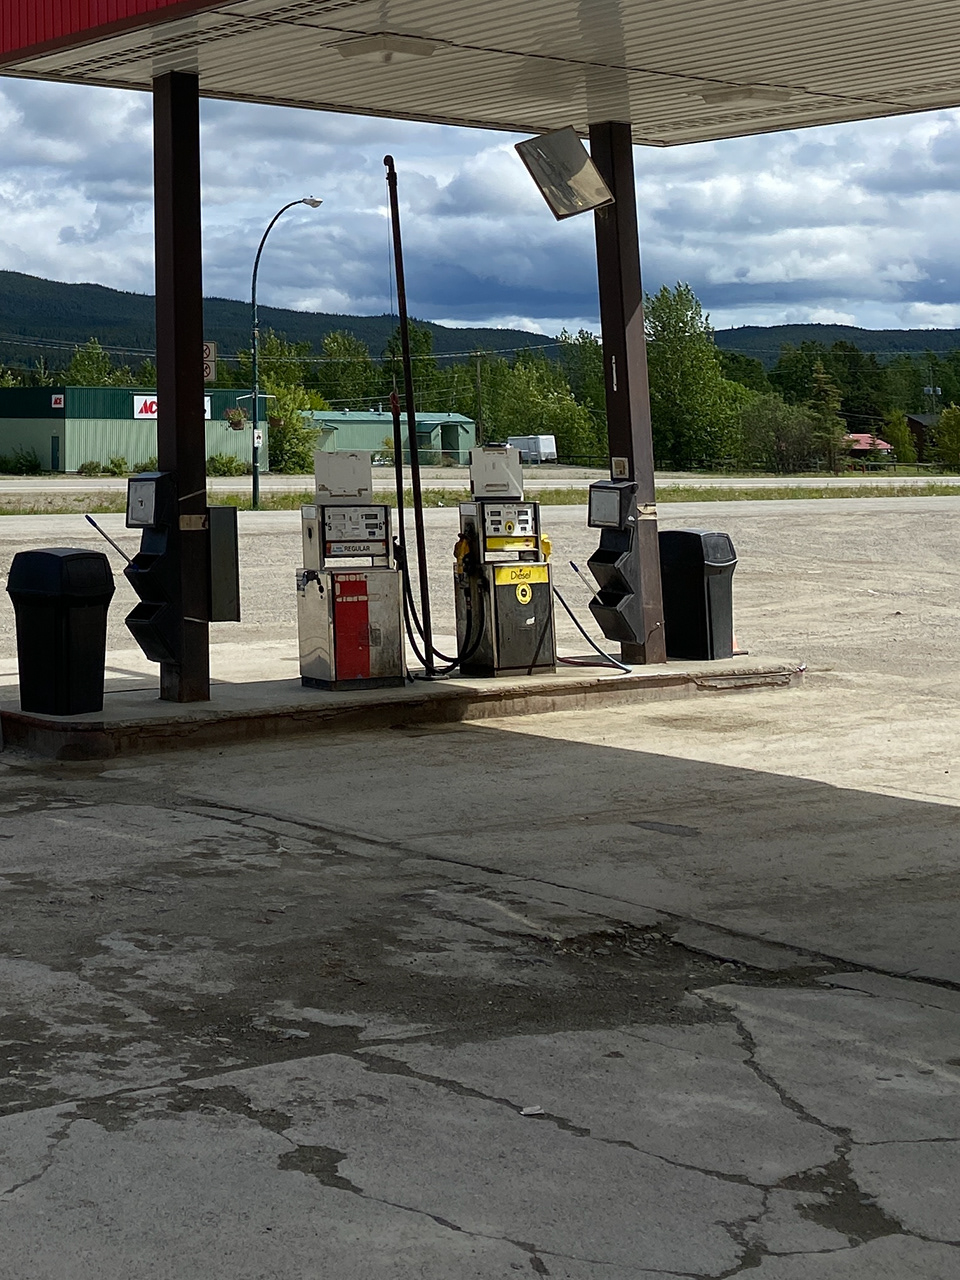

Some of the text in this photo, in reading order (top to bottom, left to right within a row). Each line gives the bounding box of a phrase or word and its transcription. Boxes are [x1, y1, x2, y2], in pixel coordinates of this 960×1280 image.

[53, 397, 62, 405] ACE
[138, 399, 157, 414] AC
[510, 570, 531, 580] Diesel
